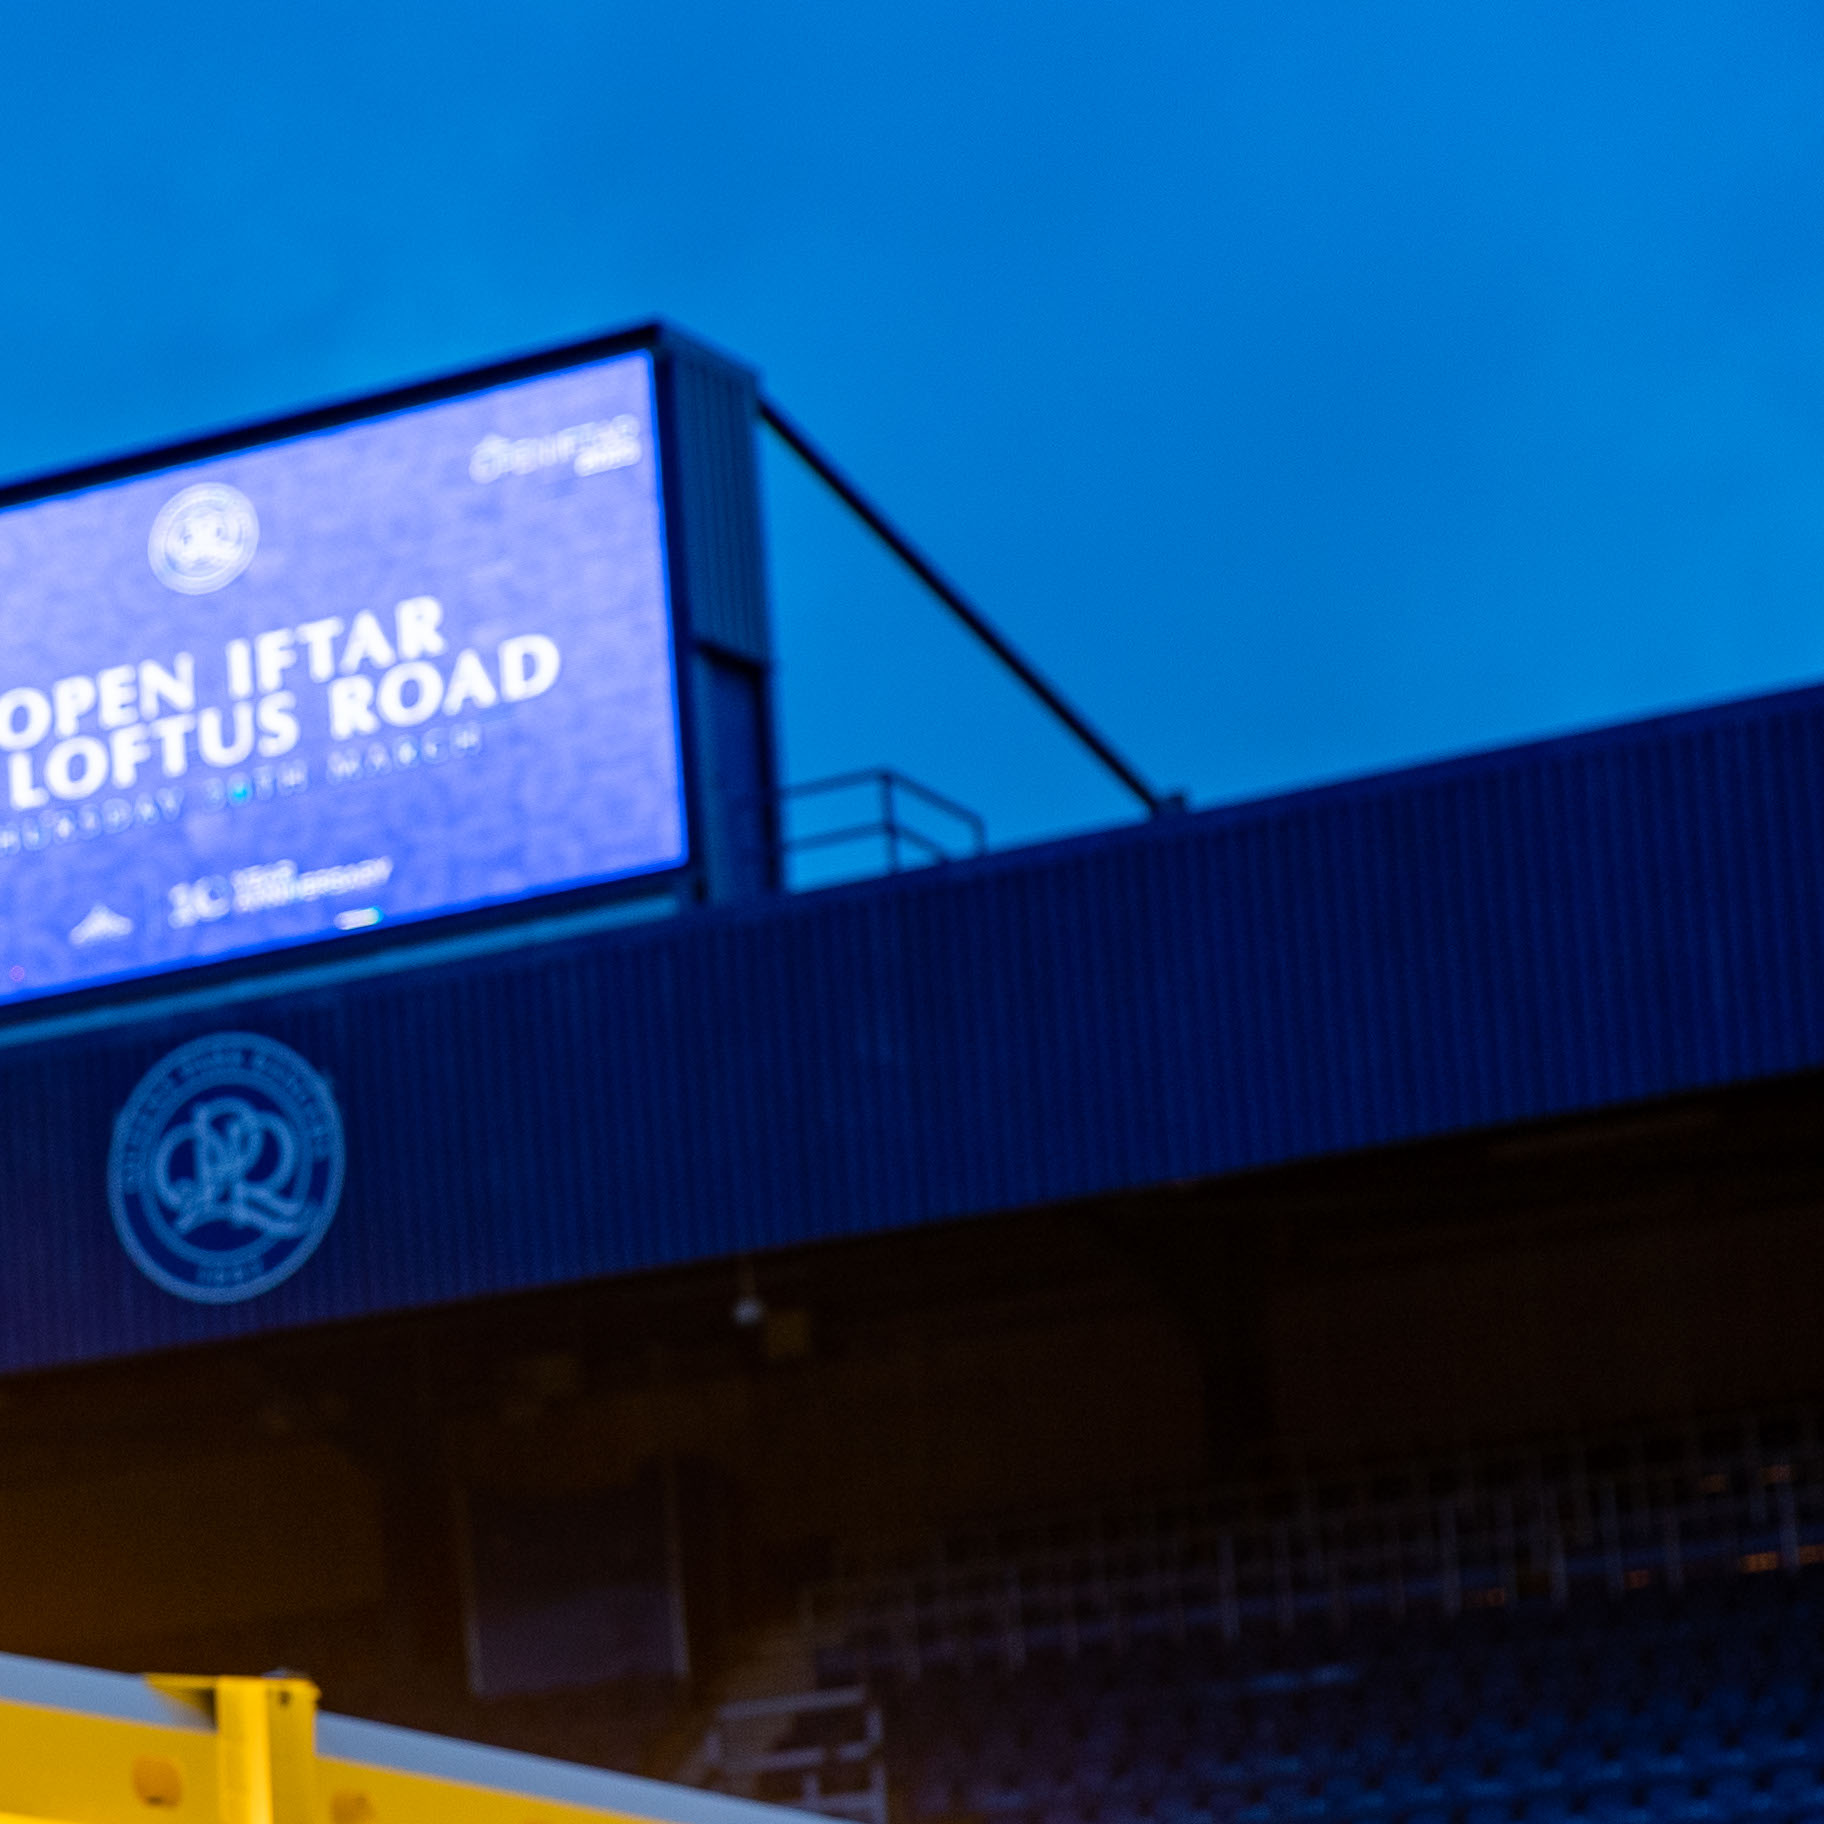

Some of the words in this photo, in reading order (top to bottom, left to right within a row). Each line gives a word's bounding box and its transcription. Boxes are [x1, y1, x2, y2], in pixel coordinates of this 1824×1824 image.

[227, 596, 446, 698] IFTAR
[9, 690, 299, 810] LOFTUS
[328, 633, 560, 739] ROAD
